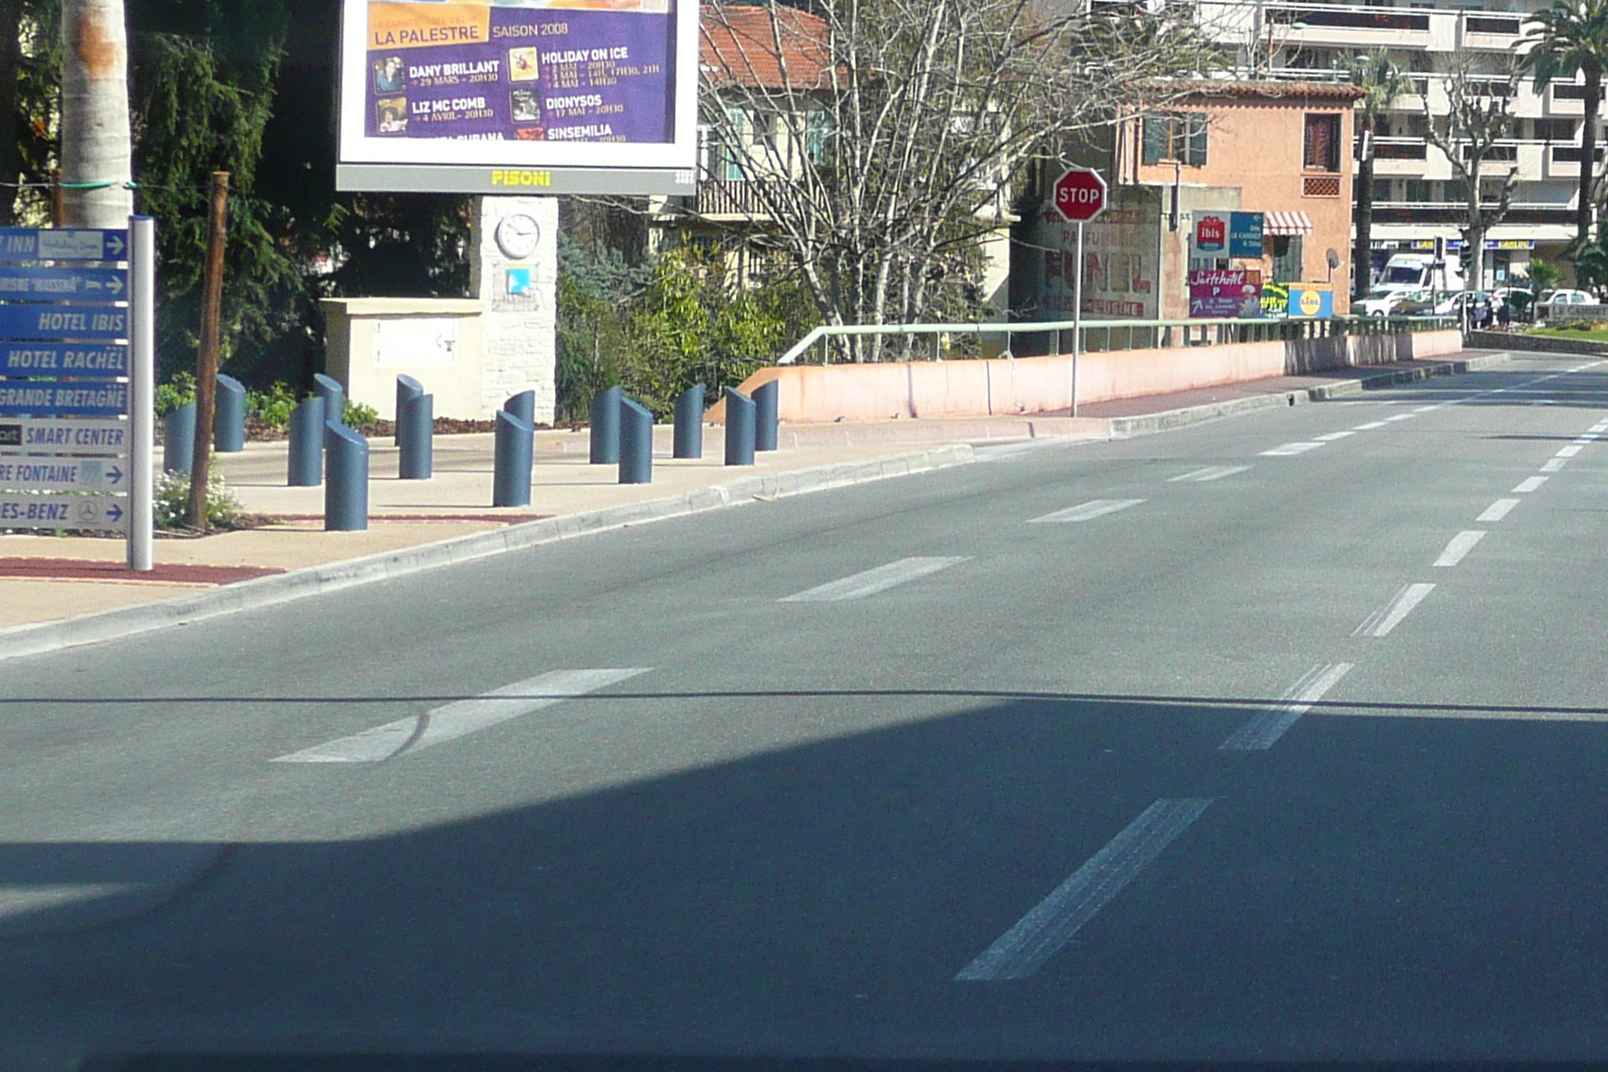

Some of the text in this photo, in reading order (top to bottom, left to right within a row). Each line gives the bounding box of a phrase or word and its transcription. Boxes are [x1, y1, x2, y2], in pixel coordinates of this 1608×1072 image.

[375, 25, 479, 46] LA PALESTRE
[493, 23, 569, 38] SAISON 2008
[541, 47, 629, 64] HOLIDAY ON ICE
[409, 60, 500, 79] DANY BRILLANT
[412, 97, 486, 114] LIZ MC COMB
[546, 95, 602, 109] DIONYSOS
[547, 124, 612, 140] SINSEMILIA
[1058, 187, 1100, 204] STOP
[1201, 226, 1220, 239] ibis
[7, 236, 36, 252] INN
[38, 313, 125, 331] HOTEL IBIS
[7, 350, 124, 369] HOTEL RACHEL
[0, 388, 125, 408] GRANDE BRETAGNE
[26, 427, 72, 445] SMART
[75, 429, 124, 446] CENTER
[16, 465, 77, 483] FONTAINE
